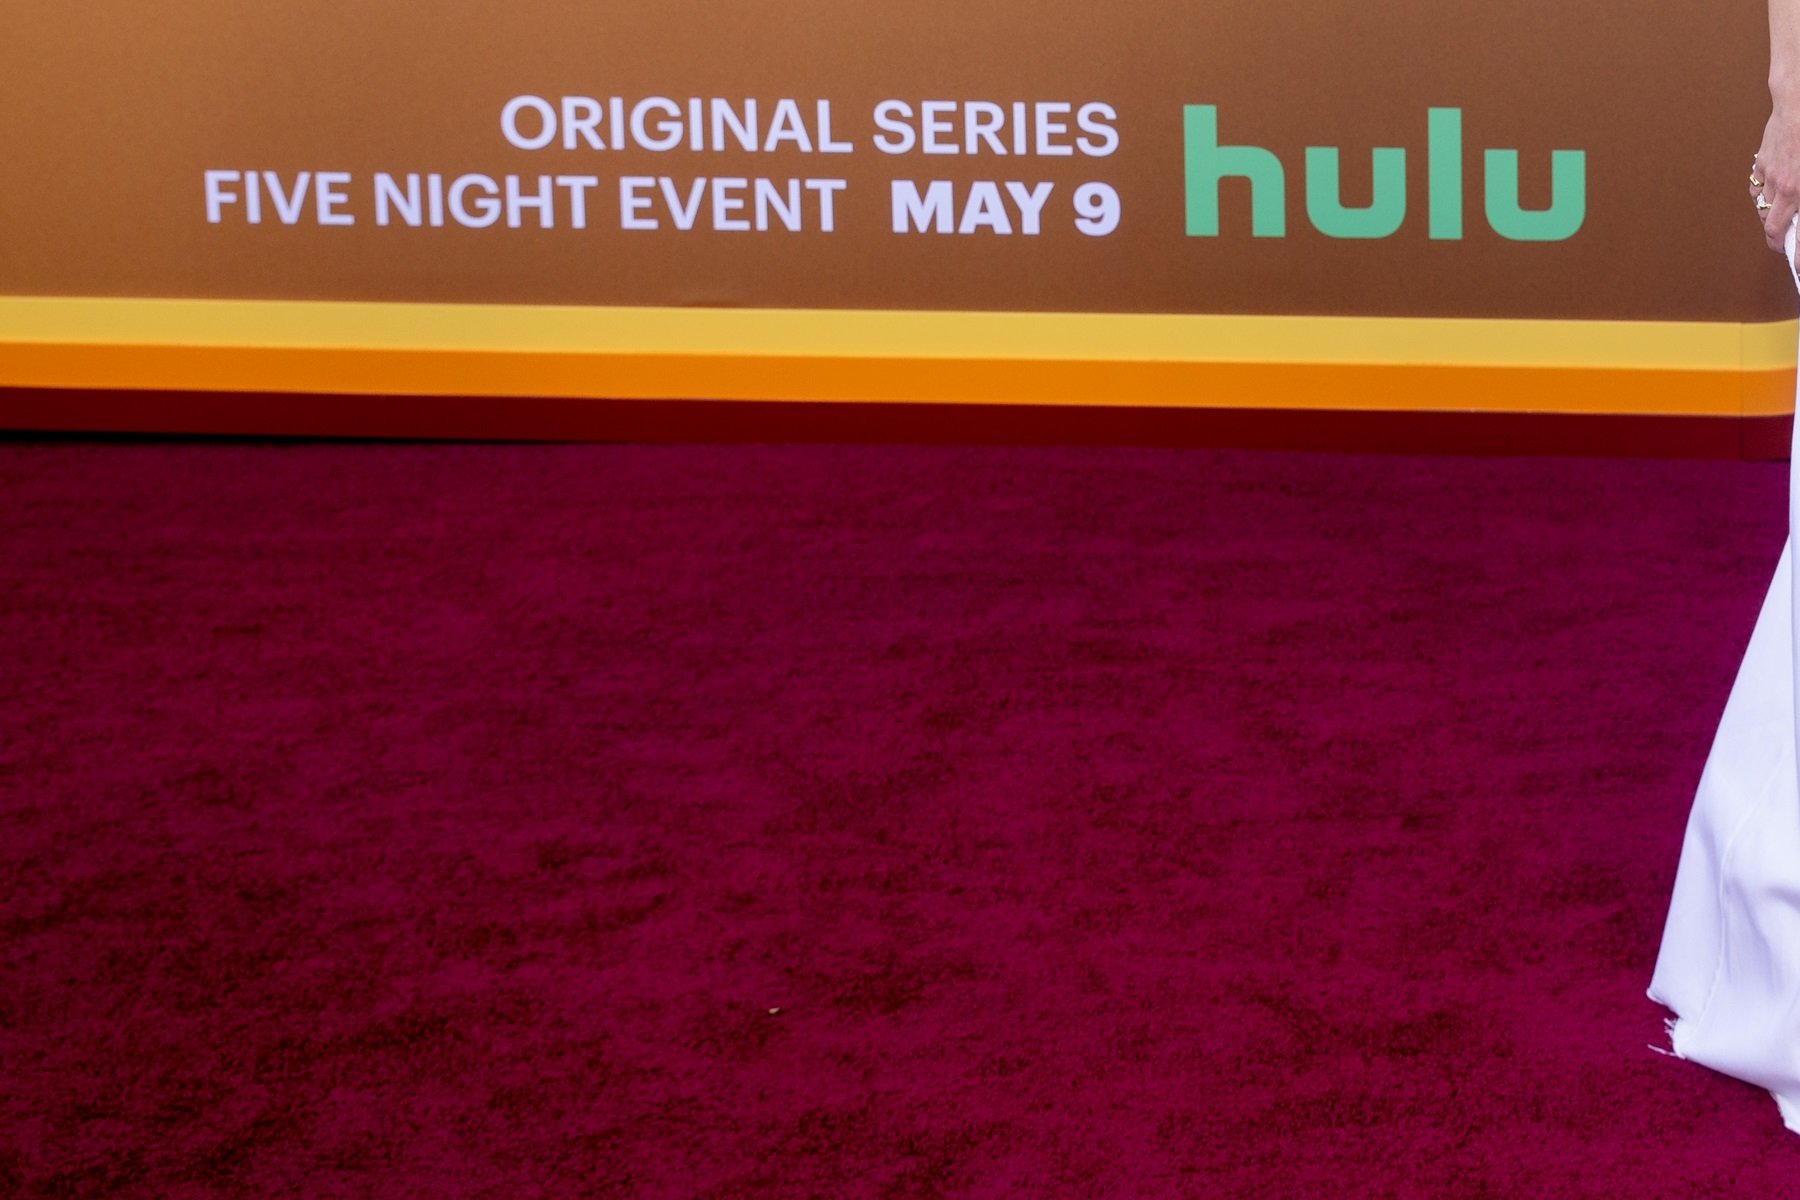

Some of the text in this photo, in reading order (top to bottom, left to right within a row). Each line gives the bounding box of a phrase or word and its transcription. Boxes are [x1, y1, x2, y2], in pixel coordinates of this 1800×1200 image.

[500, 95, 1120, 157] ORIGINAL SERIES
[204, 170, 1121, 237] FIVE NIGHT EVENT MAY 9
[1183, 104, 1587, 242] hulu
